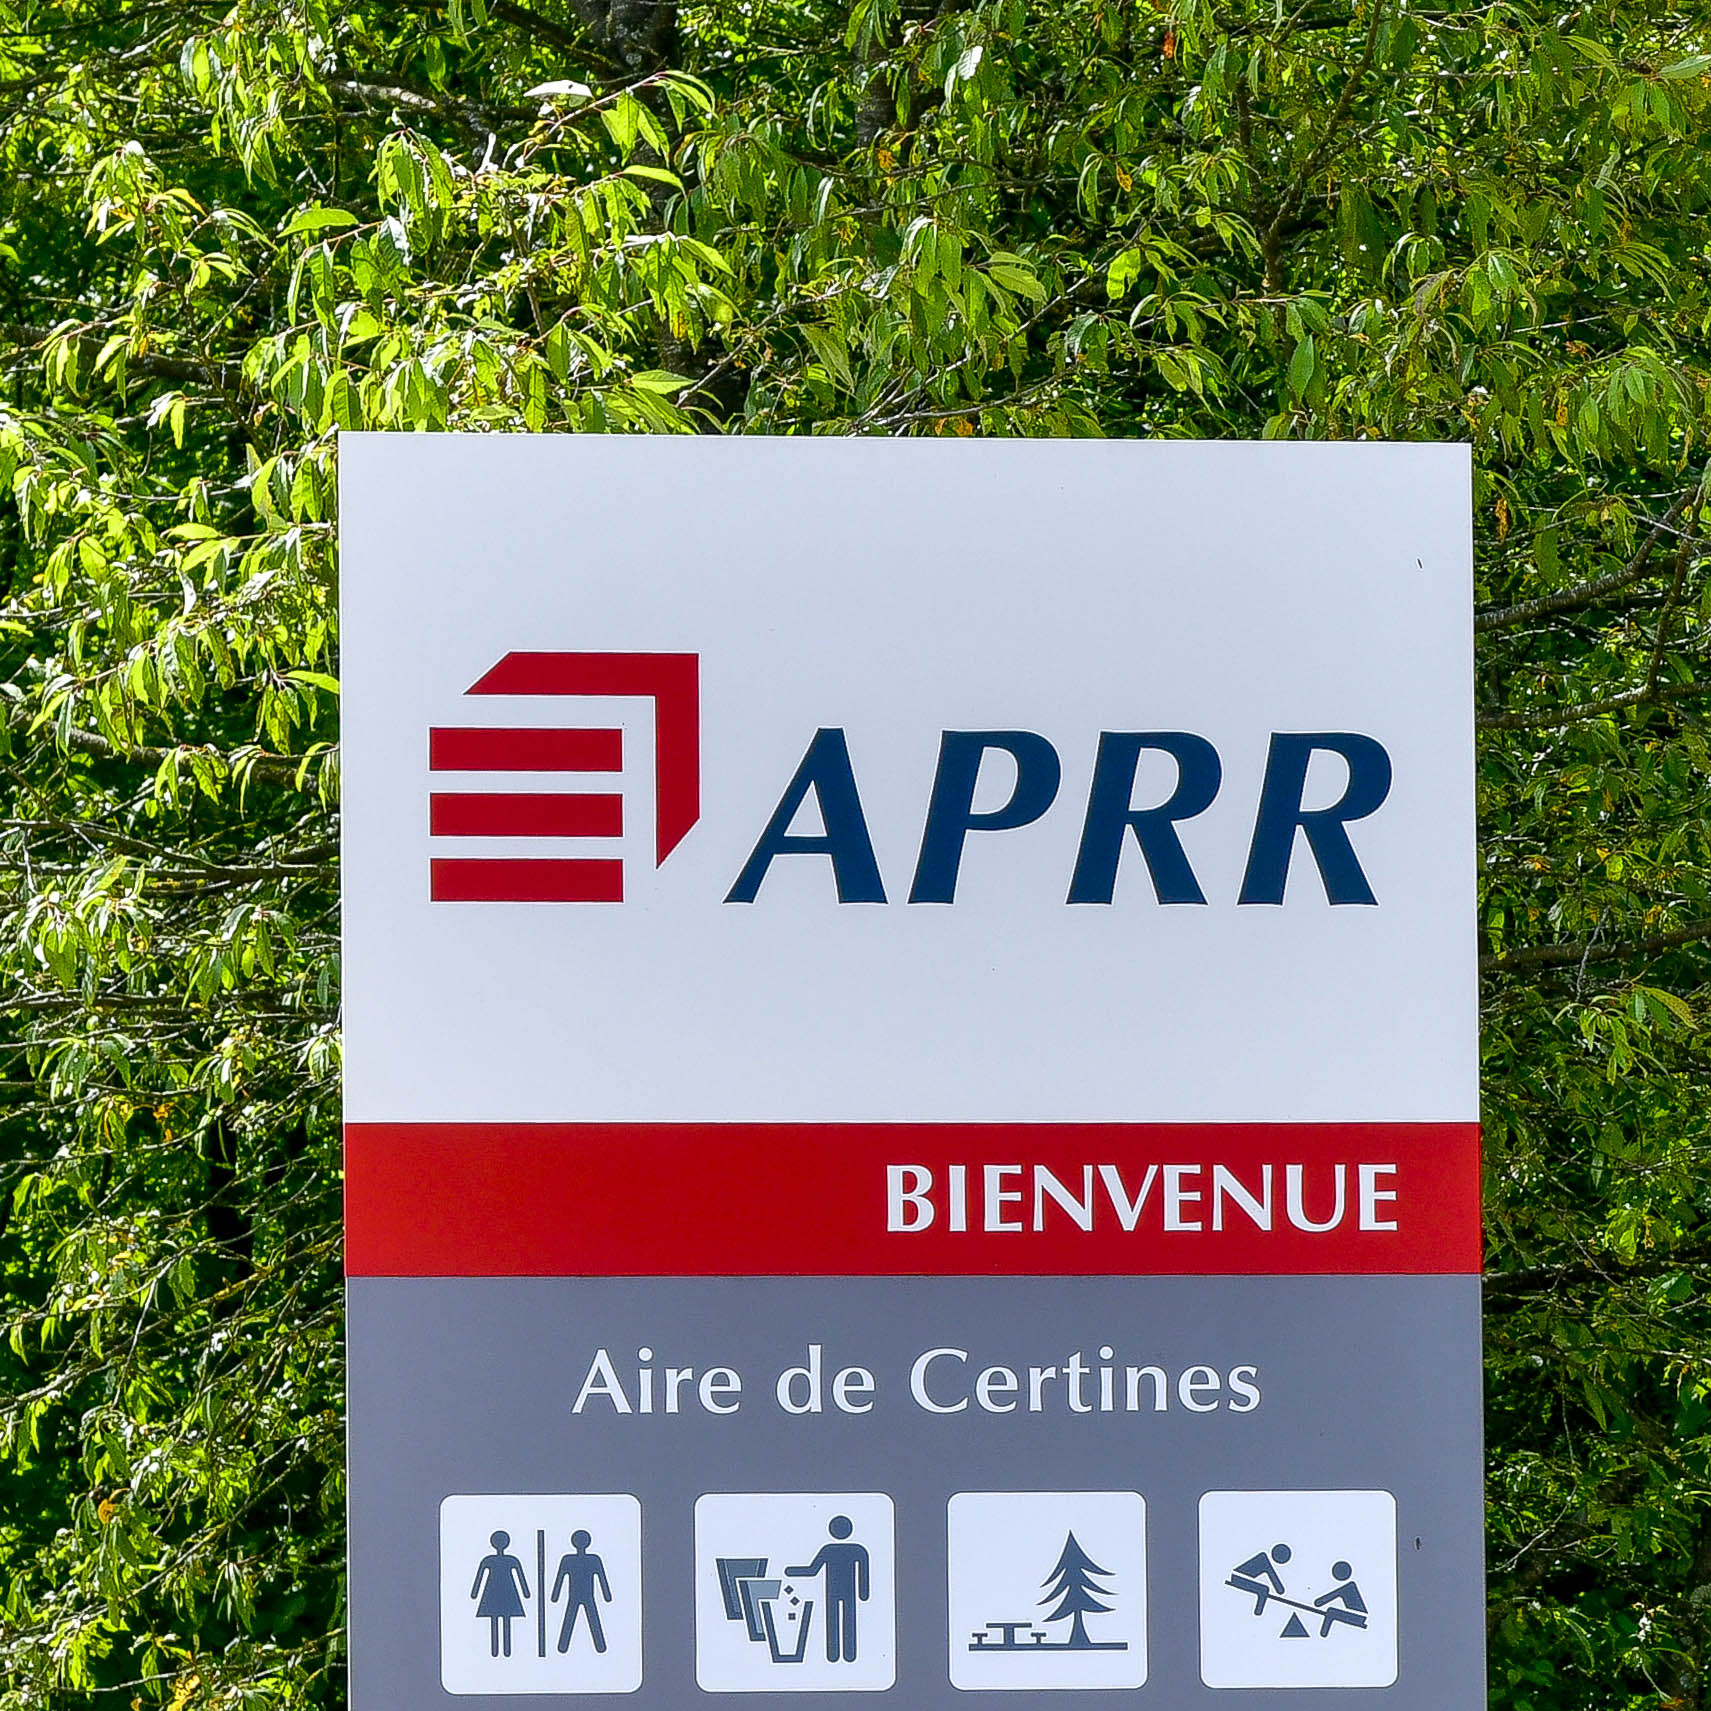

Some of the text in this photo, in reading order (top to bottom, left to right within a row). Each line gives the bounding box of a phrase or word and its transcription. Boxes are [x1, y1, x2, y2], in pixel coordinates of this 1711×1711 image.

[723, 726, 1393, 906] APRR
[886, 1162, 1399, 1233] BIENVENUE
[571, 1343, 1262, 1415] Aire de Certines
